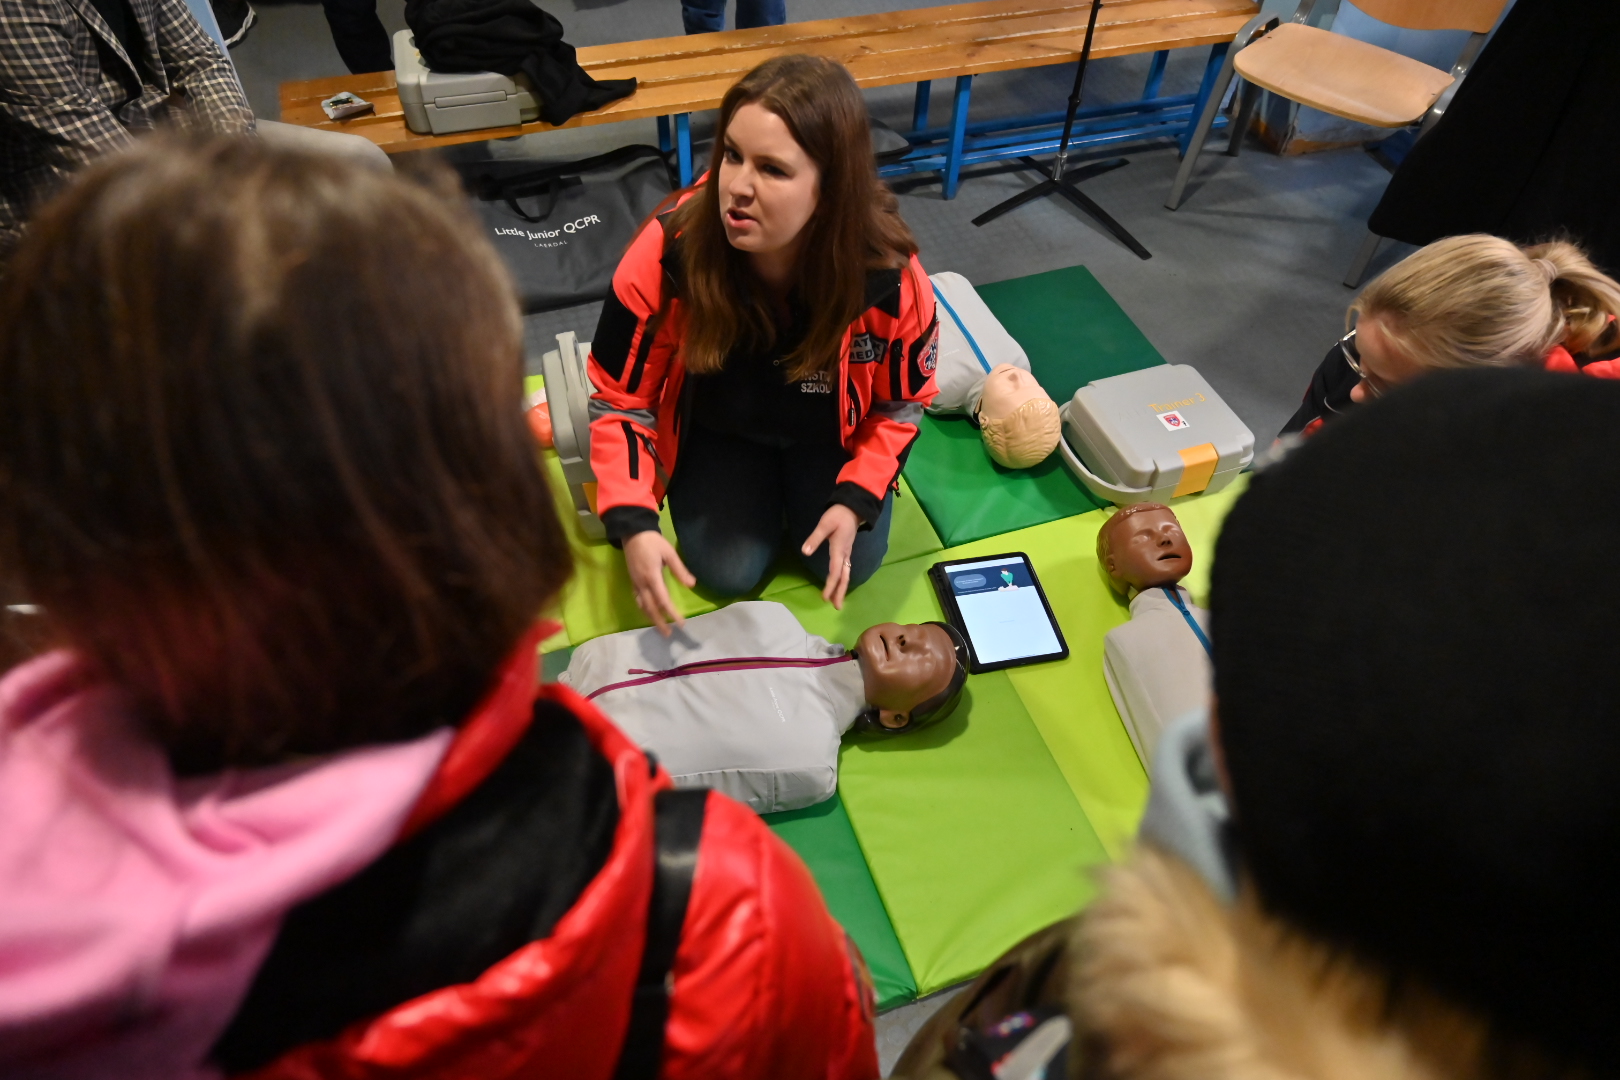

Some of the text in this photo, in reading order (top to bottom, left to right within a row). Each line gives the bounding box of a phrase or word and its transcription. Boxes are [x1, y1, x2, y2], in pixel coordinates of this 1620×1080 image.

[494, 214, 601, 241] Little Junior QCPR
[534, 240, 568, 249] LAERDAL
[800, 382, 832, 394] SZKOL
[1148, 398, 1195, 412] Trainer
[1195, 393, 1206, 402] 3
